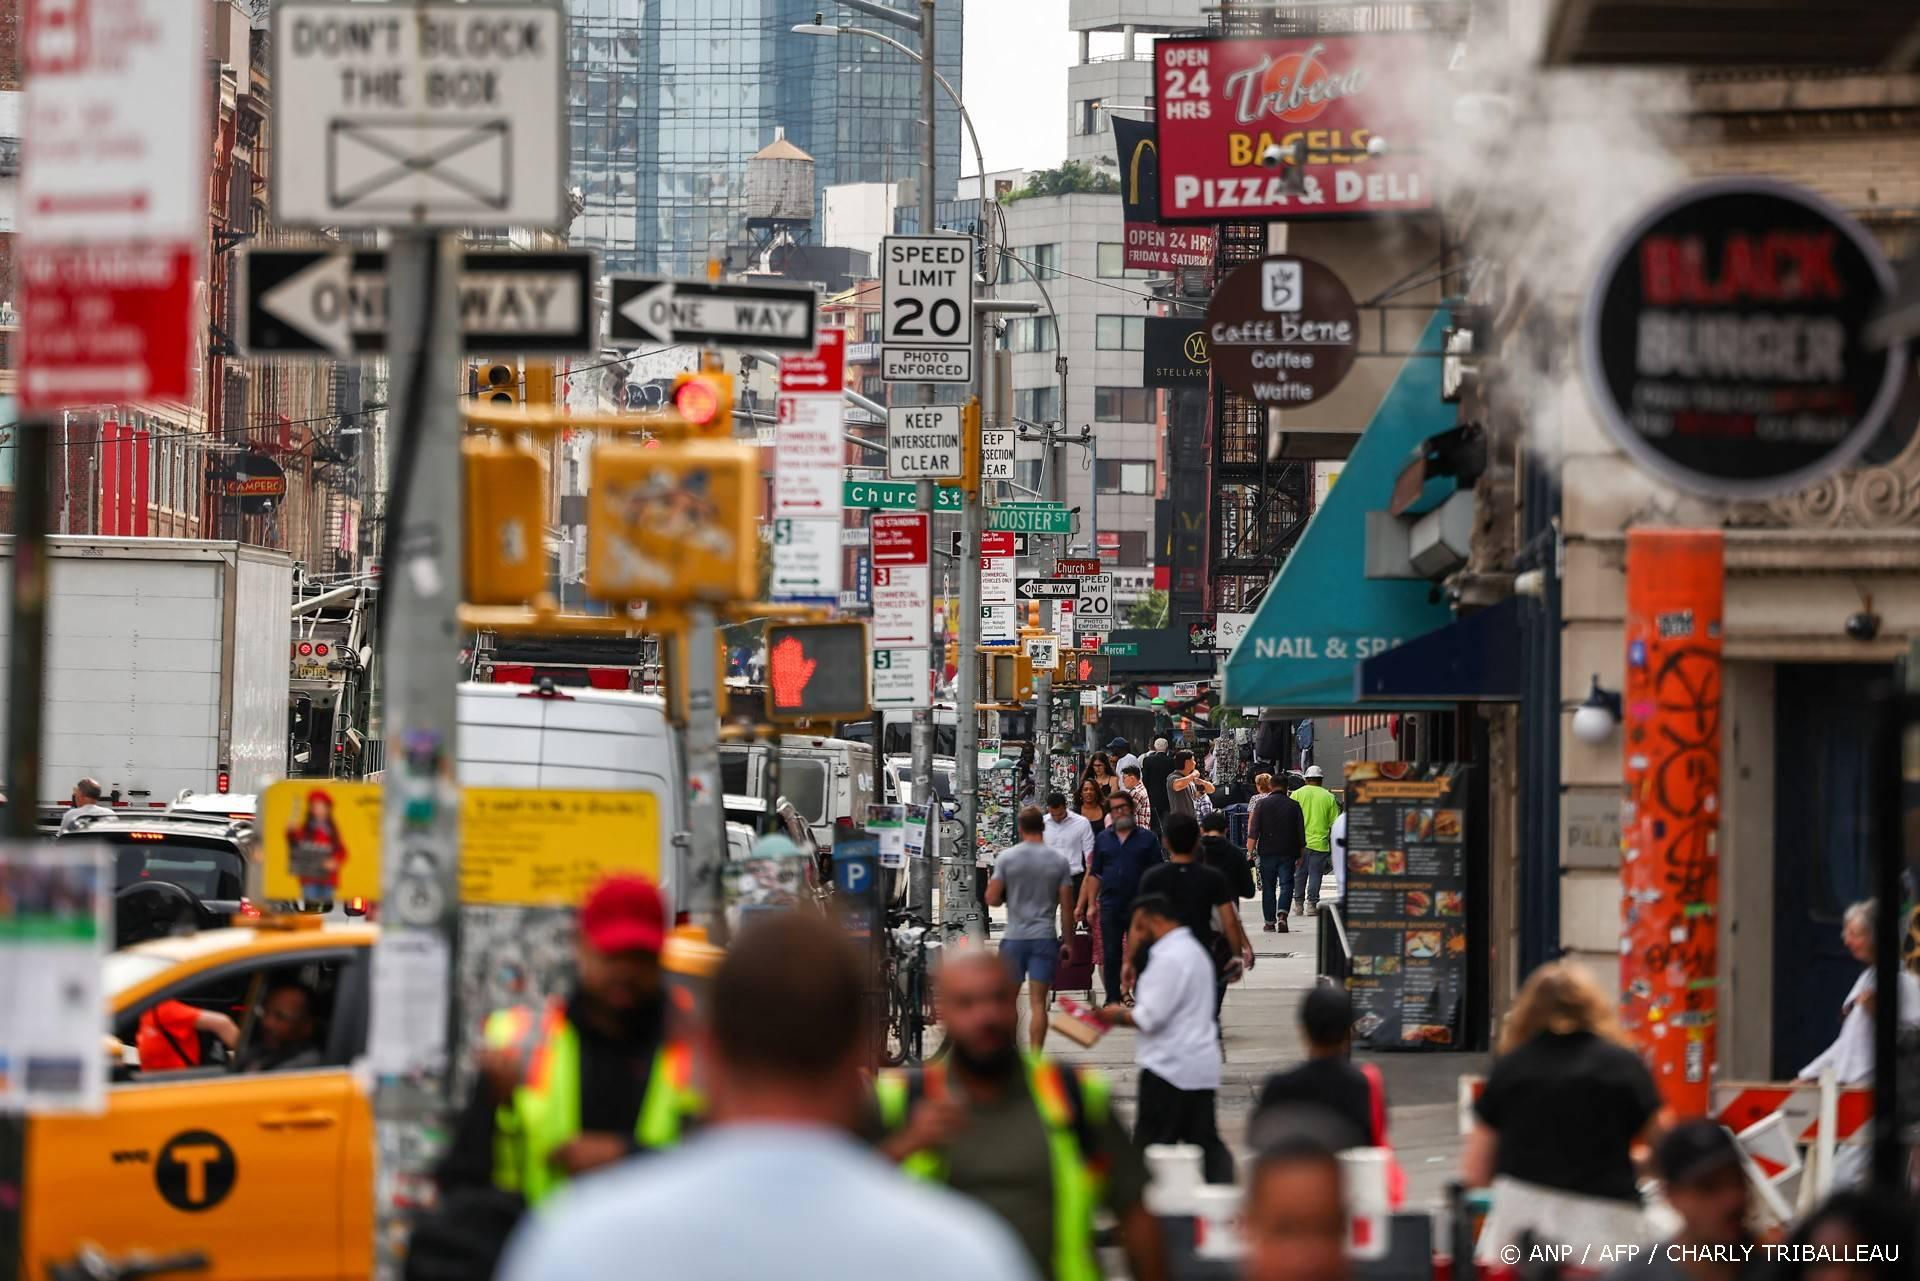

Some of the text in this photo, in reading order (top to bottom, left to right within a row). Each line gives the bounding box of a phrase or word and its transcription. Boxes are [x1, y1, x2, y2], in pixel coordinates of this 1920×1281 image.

[292, 17, 543, 57] DON'T BLOCK
[1165, 48, 1209, 66] OPEN
[341, 70, 500, 107] THE BOX
[1165, 69, 1211, 98] 24
[1166, 101, 1211, 120] HRS
[1336, 170, 1420, 203] DELI
[1128, 229, 1165, 249] OPEN
[1169, 232, 1188, 250] 24
[892, 246, 965, 264] SPEED
[1128, 250, 1160, 263] FRIDAY
[1162, 252, 1169, 263] &
[898, 270, 957, 286] LIMIT
[311, 281, 390, 326] ON
[649, 302, 796, 334] ONE WAY
[892, 298, 962, 337] 20
[1281, 312, 1352, 342] bene
[903, 352, 949, 363] PHOTO
[1251, 350, 1314, 369] Coffee
[889, 364, 963, 376] ENFORCED
[1156, 368, 1202, 377] STELLAR
[1252, 383, 1313, 401] Waffle
[905, 413, 943, 429] KEEP
[892, 435, 958, 449] INTERSECTION
[983, 434, 1004, 447] EEP
[901, 455, 949, 471] CLEAR
[852, 487, 960, 506] Churc St
[988, 510, 1068, 530] WOOSTER ST
[983, 558, 989, 569] 3
[1057, 562, 1085, 574] Church
[878, 569, 887, 585] 3
[1025, 585, 1072, 593] ONE WAY
[983, 607, 990, 617] 5
[1080, 597, 1108, 613] 20
[1104, 646, 1125, 655] Mercer
[1254, 637, 1318, 659] NAIL
[1325, 637, 1348, 659] &
[877, 651, 887, 668] 5
[847, 863, 865, 889] P
[172, 1146, 219, 1202] T
